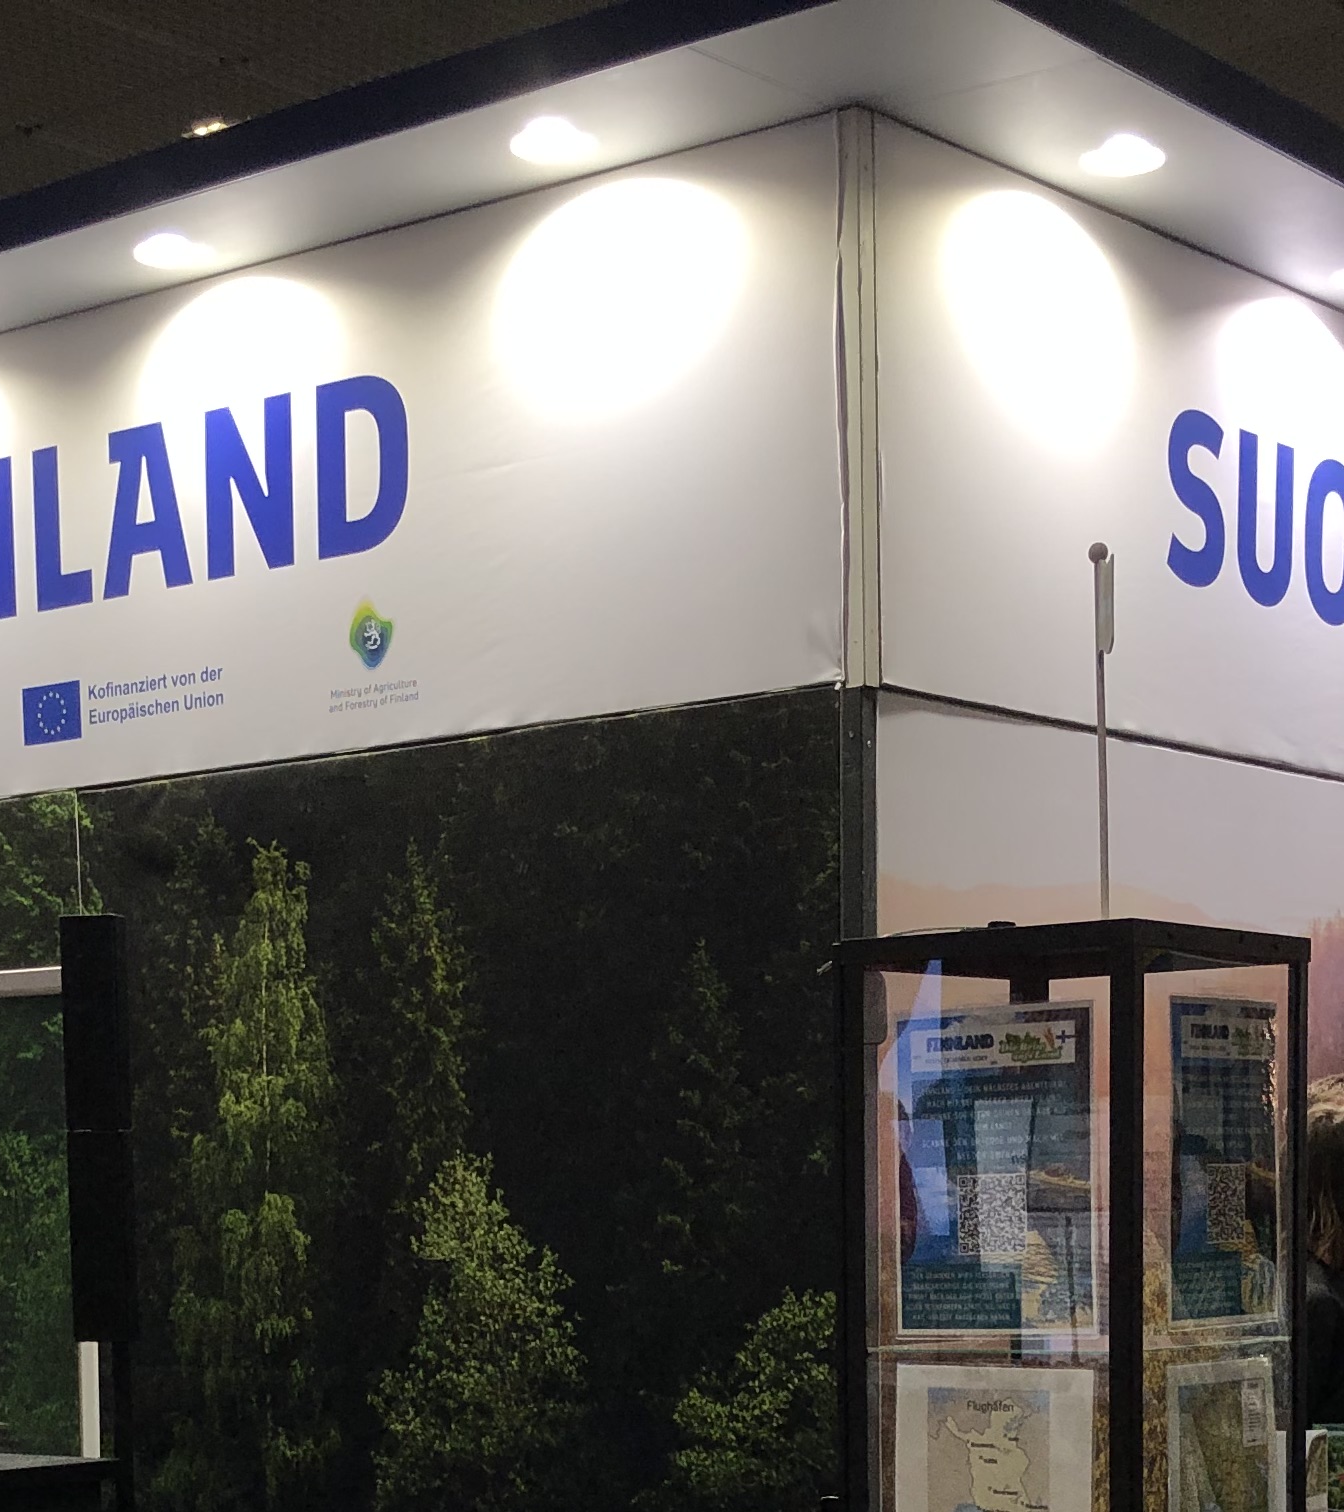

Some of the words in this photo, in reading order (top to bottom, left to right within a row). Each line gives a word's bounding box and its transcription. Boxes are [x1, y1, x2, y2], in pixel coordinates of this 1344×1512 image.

[87, 673, 167, 700] Kofinanziert
[171, 671, 196, 688] von
[200, 666, 223, 682] der
[330, 687, 362, 699] Ministry
[364, 684, 372, 694] of
[373, 680, 417, 694] Agriculture
[89, 697, 180, 725] Europäischen
[184, 691, 224, 711] Union
[328, 703, 343, 713] and
[345, 698, 378, 710] Forestry
[380, 695, 388, 706] of
[389, 692, 419, 704] Finland
[967, 1400, 1014, 1414] Flughäfen
